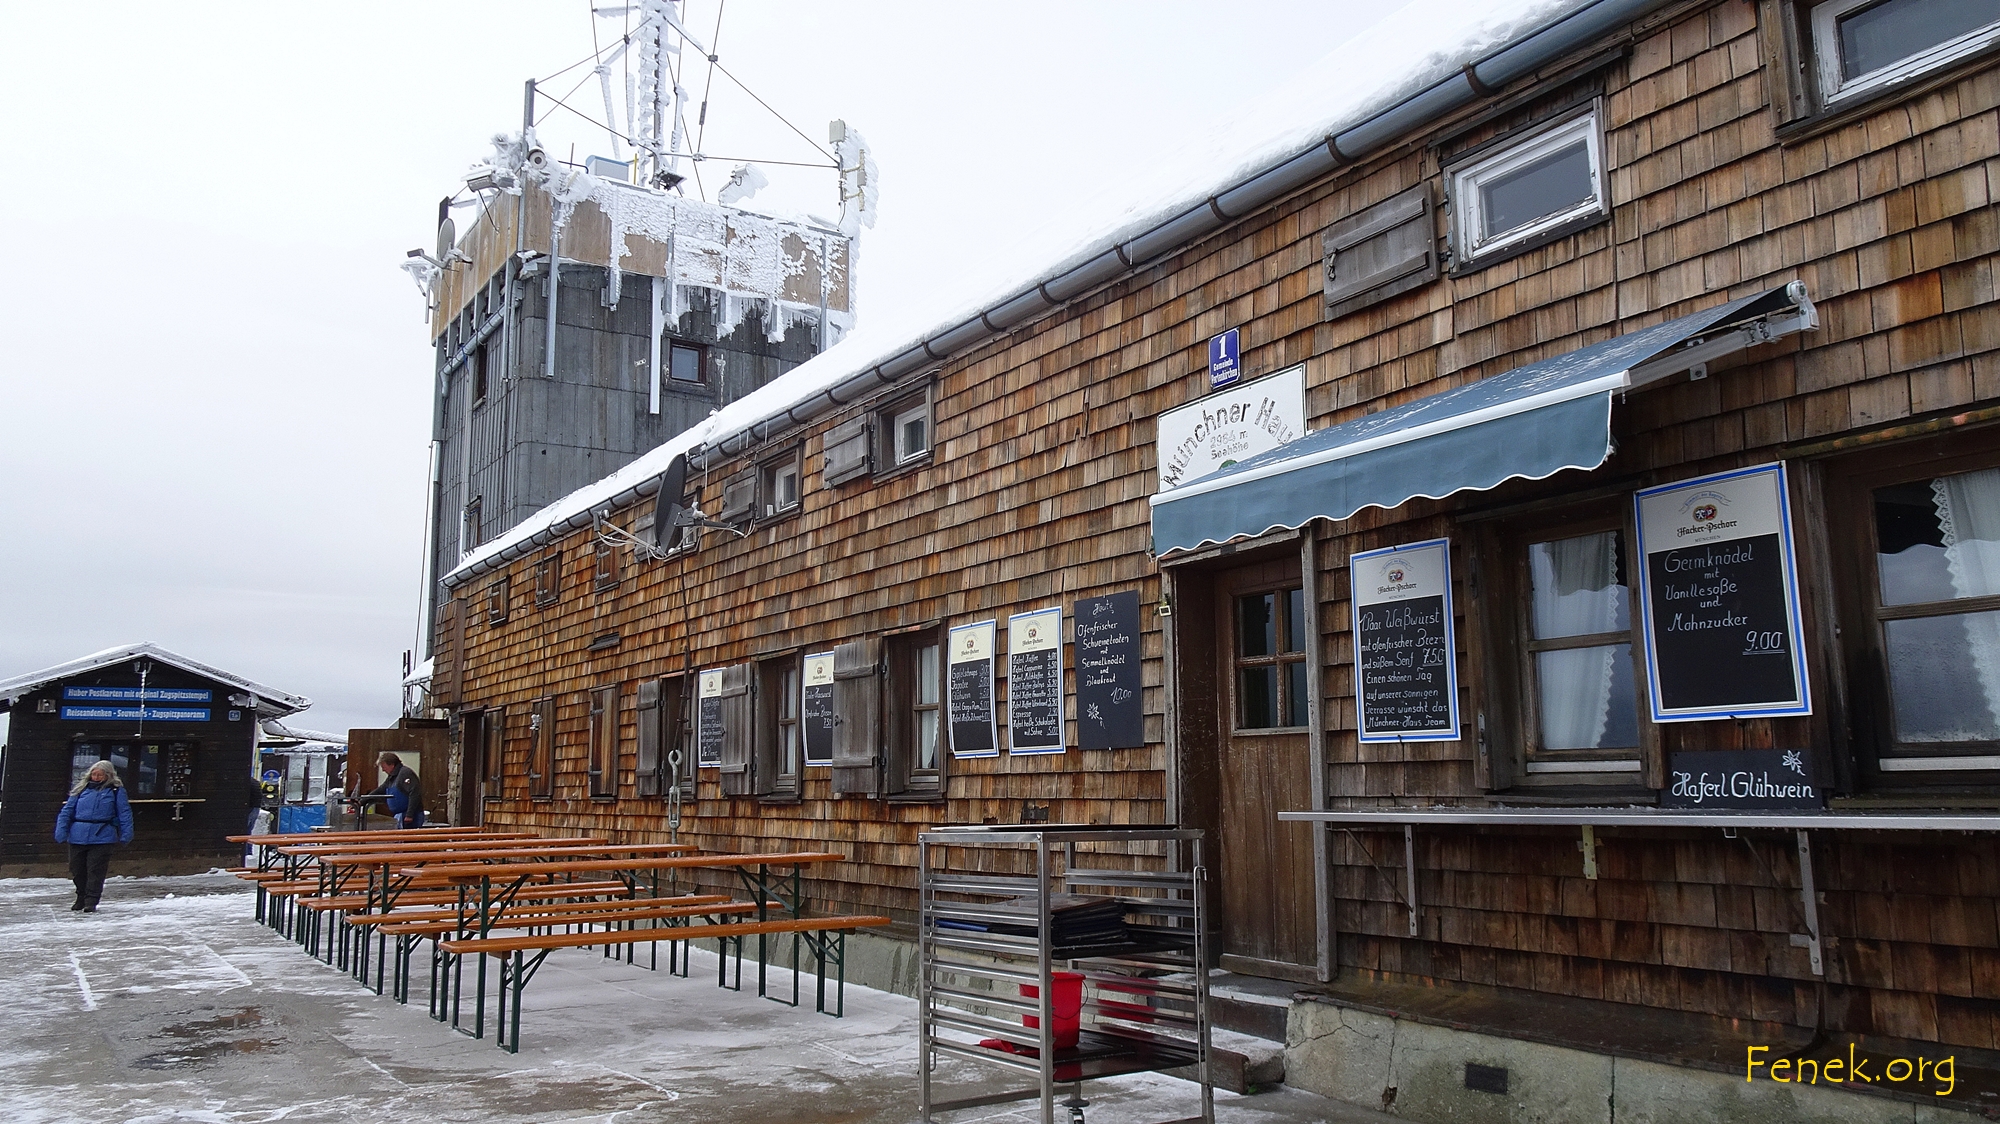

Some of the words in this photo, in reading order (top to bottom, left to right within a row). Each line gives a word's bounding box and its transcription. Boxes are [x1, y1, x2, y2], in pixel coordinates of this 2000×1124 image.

[1219, 336, 1227, 359] 1
[1163, 403, 1250, 486] Münchner
[1254, 397, 1293, 445] Hau
[1211, 442, 1249, 460] Seehöhe
[1664, 543, 1754, 573] Germknödel
[1704, 567, 1721, 579] mit
[1700, 596, 1723, 608] und
[1667, 610, 1748, 632] Mohnzucker
[1745, 630, 1783, 652] 9.00
[1395, 651, 1414, 667] Senf
[1423, 648, 1445, 663] 7.50
[1100, 666, 1109, 674] und
[1366, 672, 1386, 684] Einen
[1387, 671, 1412, 683] schönen
[1416, 667, 1432, 683] Tag
[68, 688, 88, 697] Huber
[89, 688, 123, 698] Postkarten
[123, 689, 135, 698] mit
[1366, 689, 1378, 701] auf
[1403, 690, 1439, 699] sonnigen
[66, 708, 112, 717] Reiseandenken
[1365, 703, 1395, 715] Terrasse
[1432, 701, 1448, 713] das
[1424, 715, 1446, 726] Team
[1672, 771, 1729, 803] Haferl
[1731, 771, 1814, 798] Glühwein
